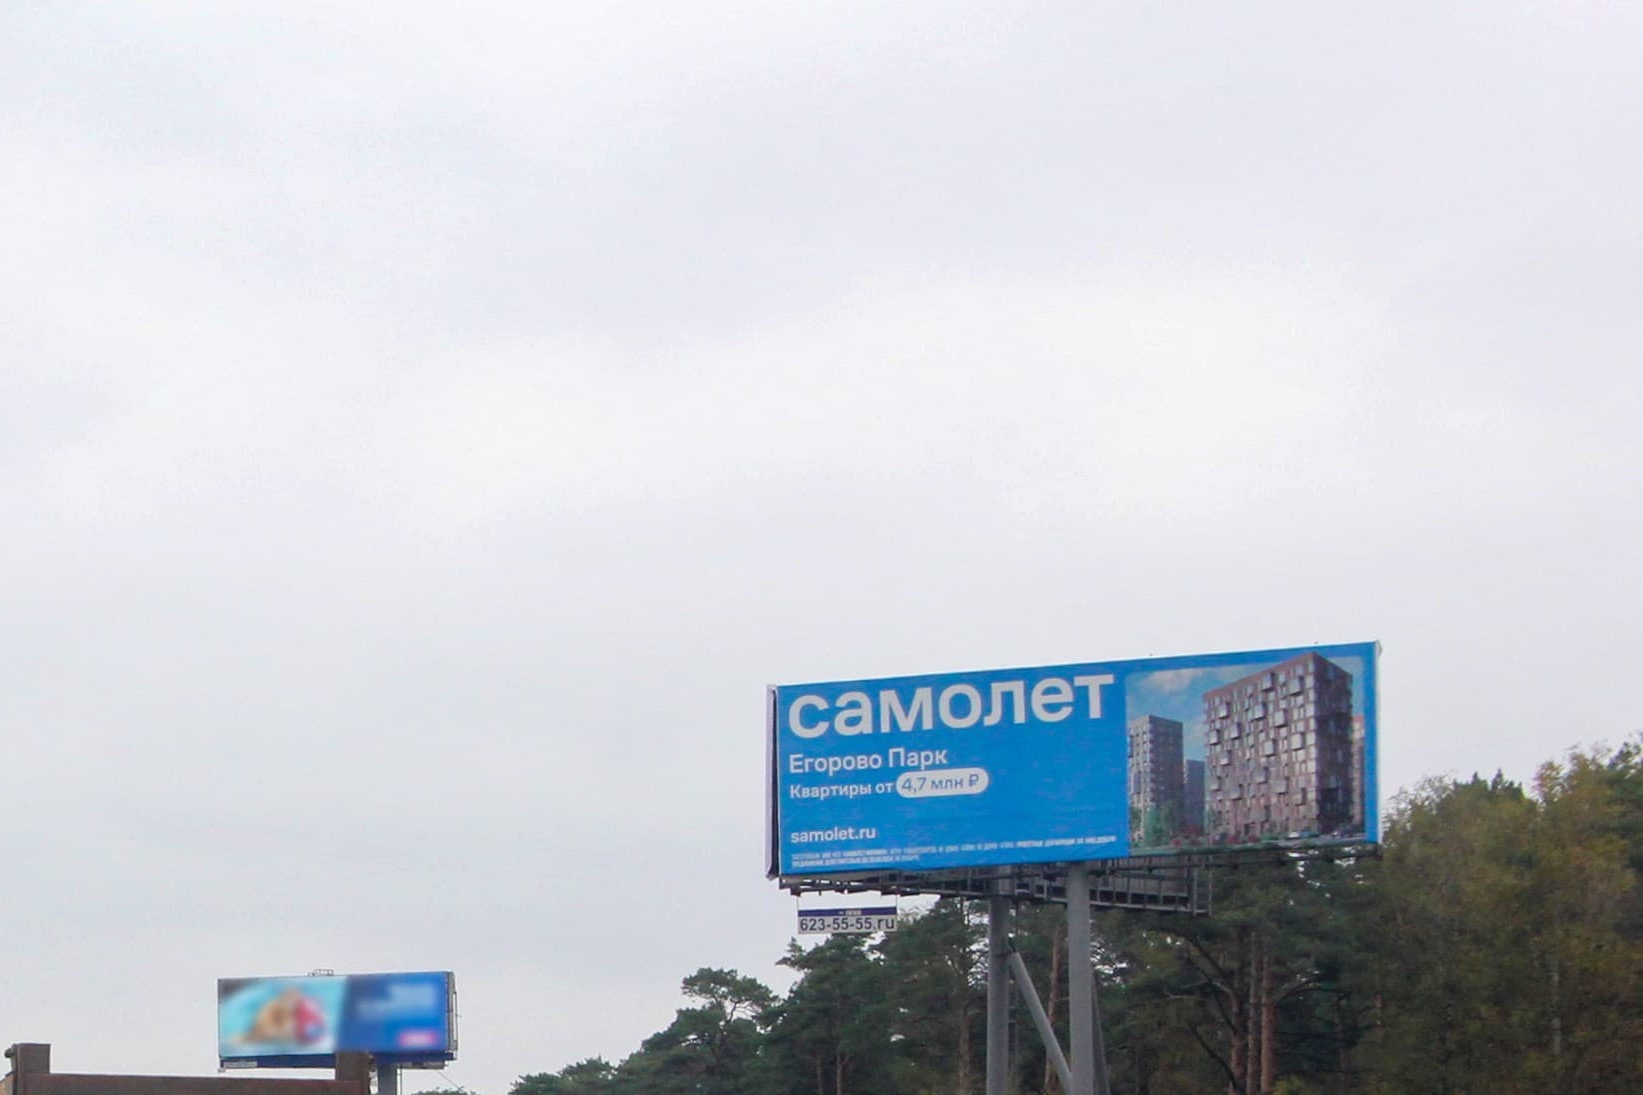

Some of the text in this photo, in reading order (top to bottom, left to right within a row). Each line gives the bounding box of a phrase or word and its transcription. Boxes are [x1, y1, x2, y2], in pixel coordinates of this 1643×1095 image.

[789, 673, 1114, 738] самолет
[789, 747, 948, 776] Егорово Парк
[790, 783, 872, 800] Квартиры
[875, 782, 894, 794] от
[901, 776, 927, 793] 4,7
[930, 778, 964, 790] млн
[791, 825, 876, 844] samolet.ru
[799, 917, 895, 931] 623-55-55.ru
